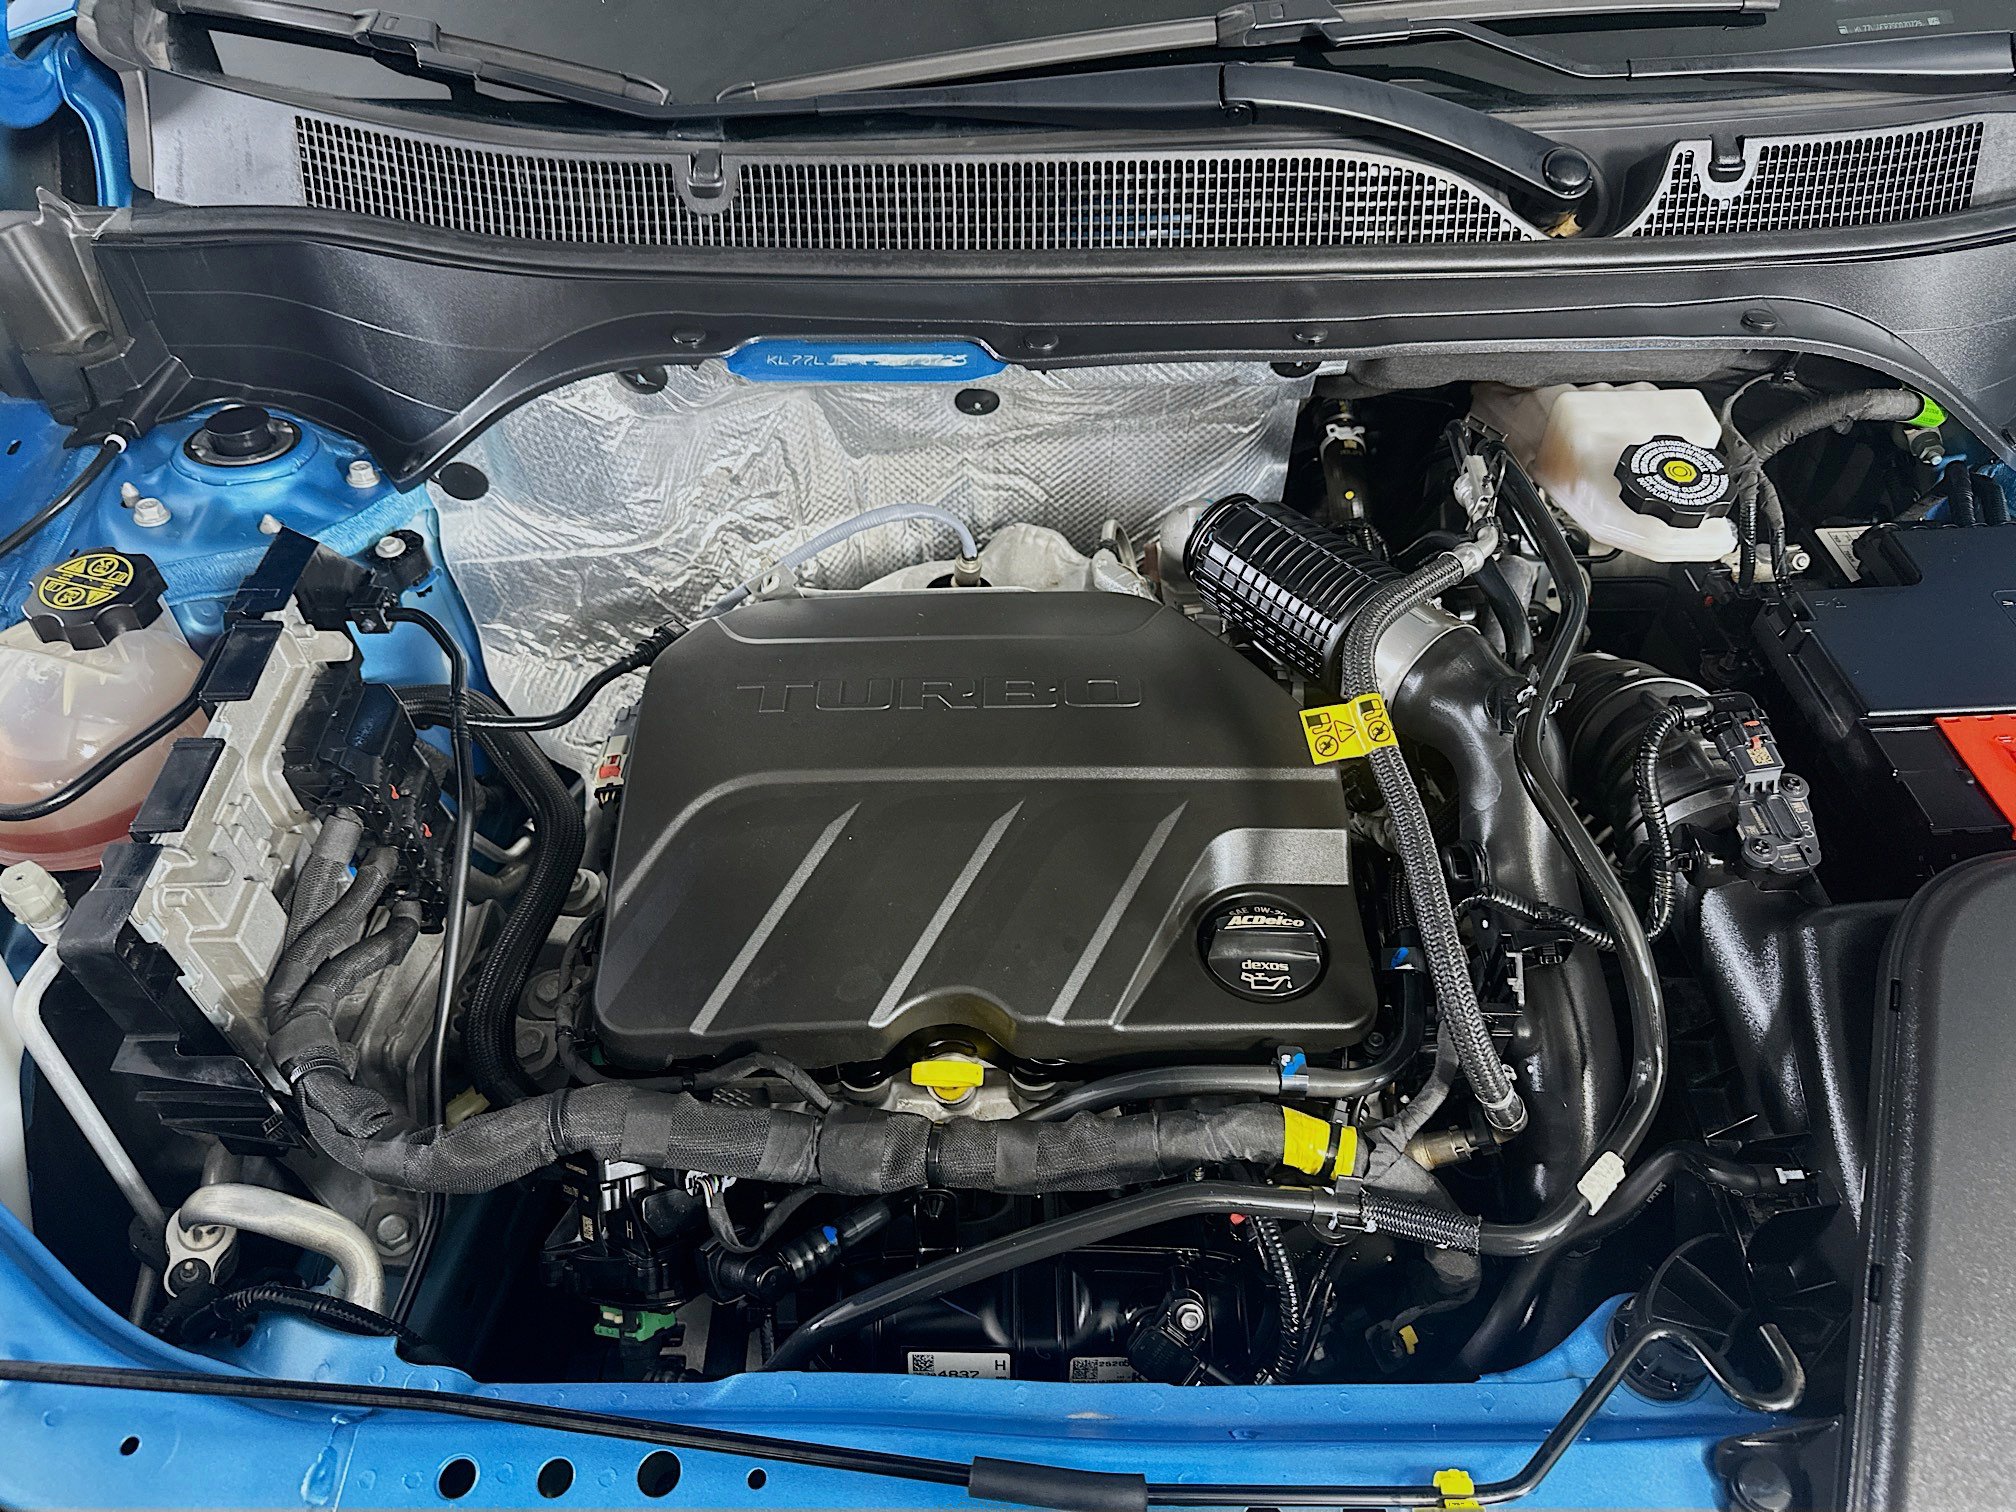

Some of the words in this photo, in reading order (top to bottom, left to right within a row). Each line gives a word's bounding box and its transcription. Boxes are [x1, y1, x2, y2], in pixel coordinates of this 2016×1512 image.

[736, 677, 1143, 713] TURBO
[1228, 906, 1249, 916] SAE
[1226, 915, 1305, 928] ACDelco
[1241, 959, 1290, 972] dexos
[994, 1359, 1007, 1371] H
